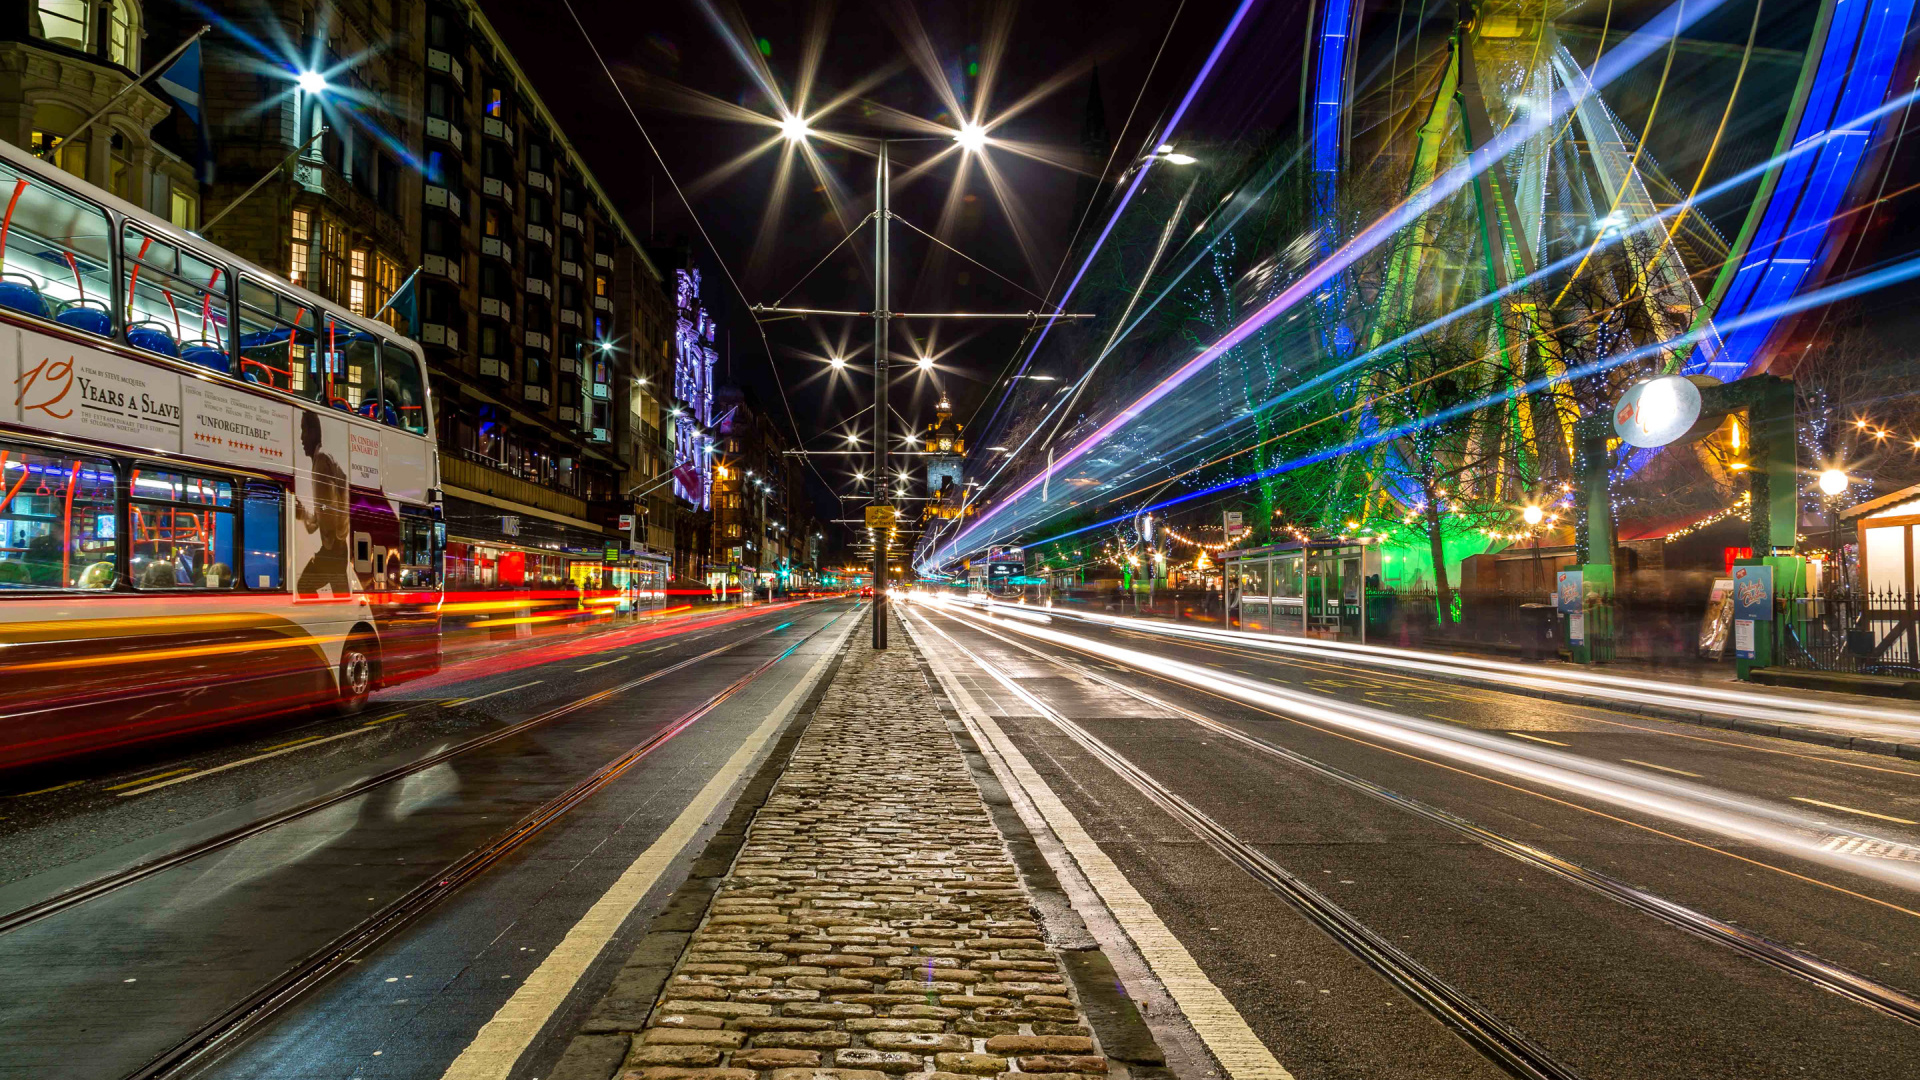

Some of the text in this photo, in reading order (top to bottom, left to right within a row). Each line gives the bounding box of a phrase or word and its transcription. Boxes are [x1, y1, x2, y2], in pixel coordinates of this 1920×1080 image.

[104, 372, 120, 381] STEVE
[14, 355, 74, 419] 12
[77, 376, 180, 420] YEARS A SLAVE
[89, 419, 115, 429] SOLOMON
[93, 413, 136, 427] EXTRAORDINARY
[149, 425, 164, 433] STORY
[358, 436, 378, 448] CINEMAS
[352, 443, 372, 455] JANUARY
[352, 463, 362, 471] BOOK
